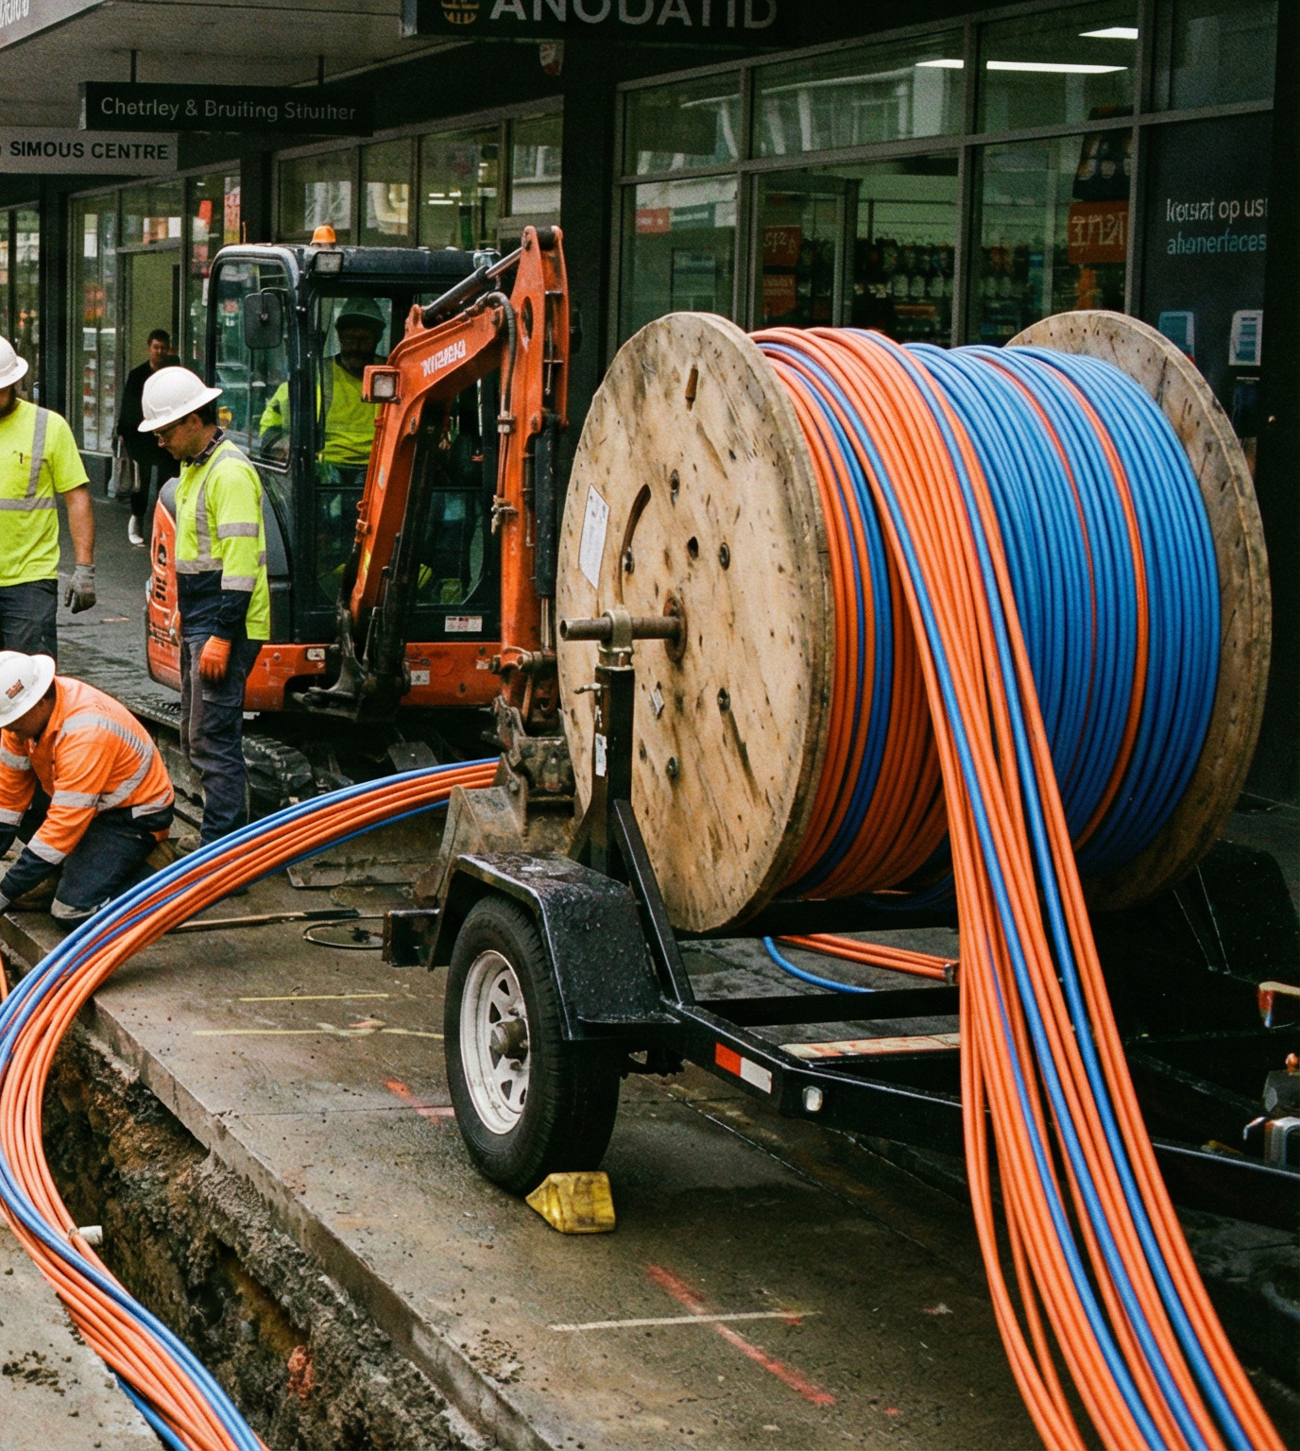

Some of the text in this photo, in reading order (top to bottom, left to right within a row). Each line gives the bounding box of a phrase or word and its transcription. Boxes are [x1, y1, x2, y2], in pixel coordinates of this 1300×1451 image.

[185, 99, 199, 116] &
[9, 141, 170, 160] SIMOUS CENTRE
